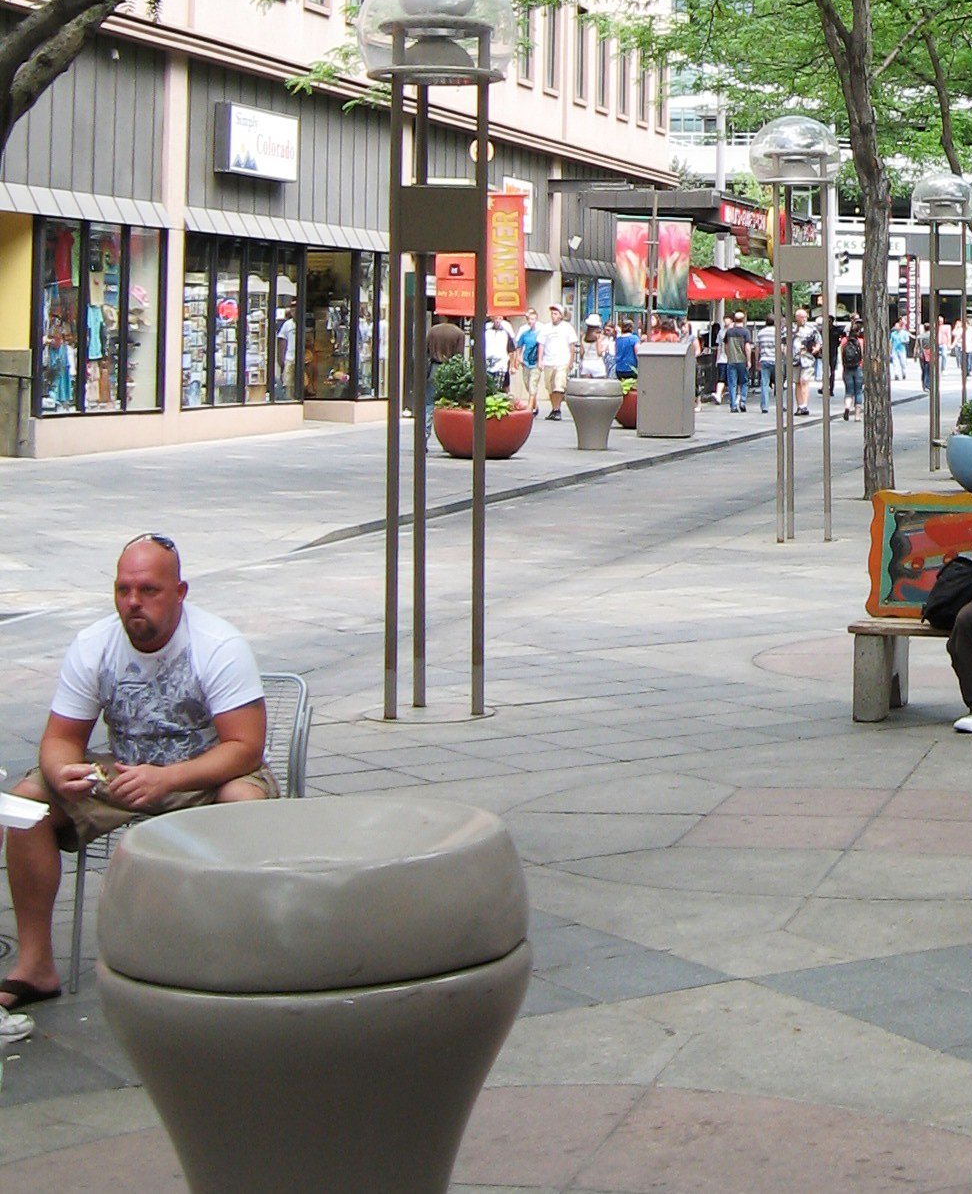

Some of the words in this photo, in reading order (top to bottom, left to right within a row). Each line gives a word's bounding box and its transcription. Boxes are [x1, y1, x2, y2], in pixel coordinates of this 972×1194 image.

[236, 112, 258, 133] Simply
[256, 134, 295, 160] Colorado
[492, 210, 520, 307] DENVER
